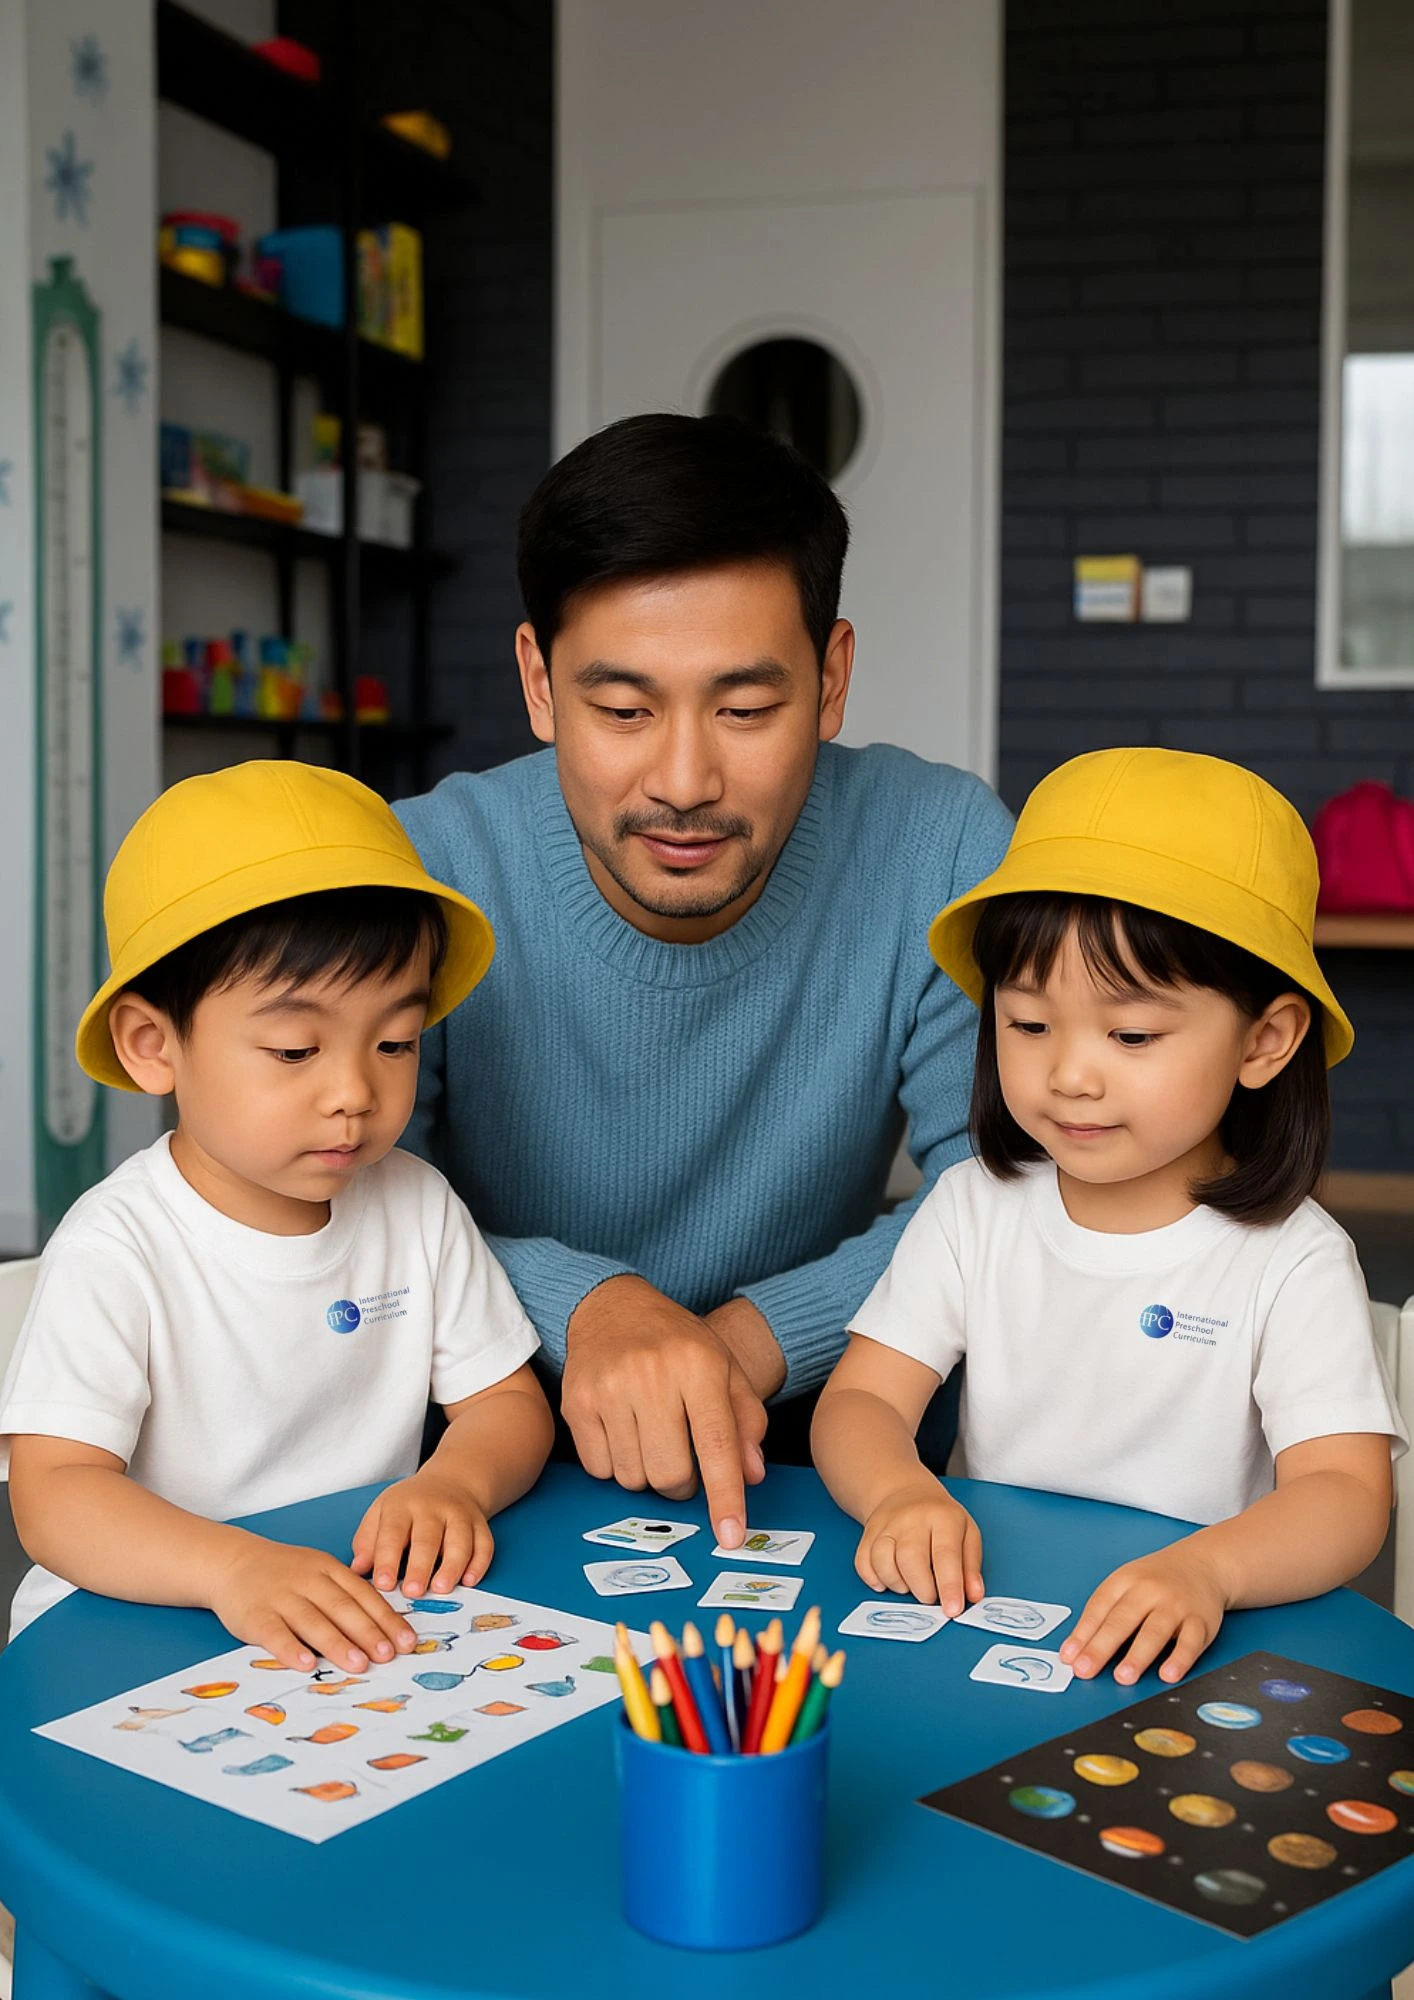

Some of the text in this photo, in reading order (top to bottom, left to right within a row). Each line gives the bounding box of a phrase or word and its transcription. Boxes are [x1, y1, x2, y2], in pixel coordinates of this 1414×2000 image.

[359, 1286, 410, 1305] International
[361, 1299, 400, 1315] Preschool
[328, 1306, 358, 1327] IPC
[363, 1309, 408, 1325] Curriculum
[1141, 1311, 1171, 1331] IPC
[1176, 1311, 1229, 1328] International
[1175, 1321, 1214, 1335] Preschool
[1173, 1331, 1217, 1347] Curriculum
